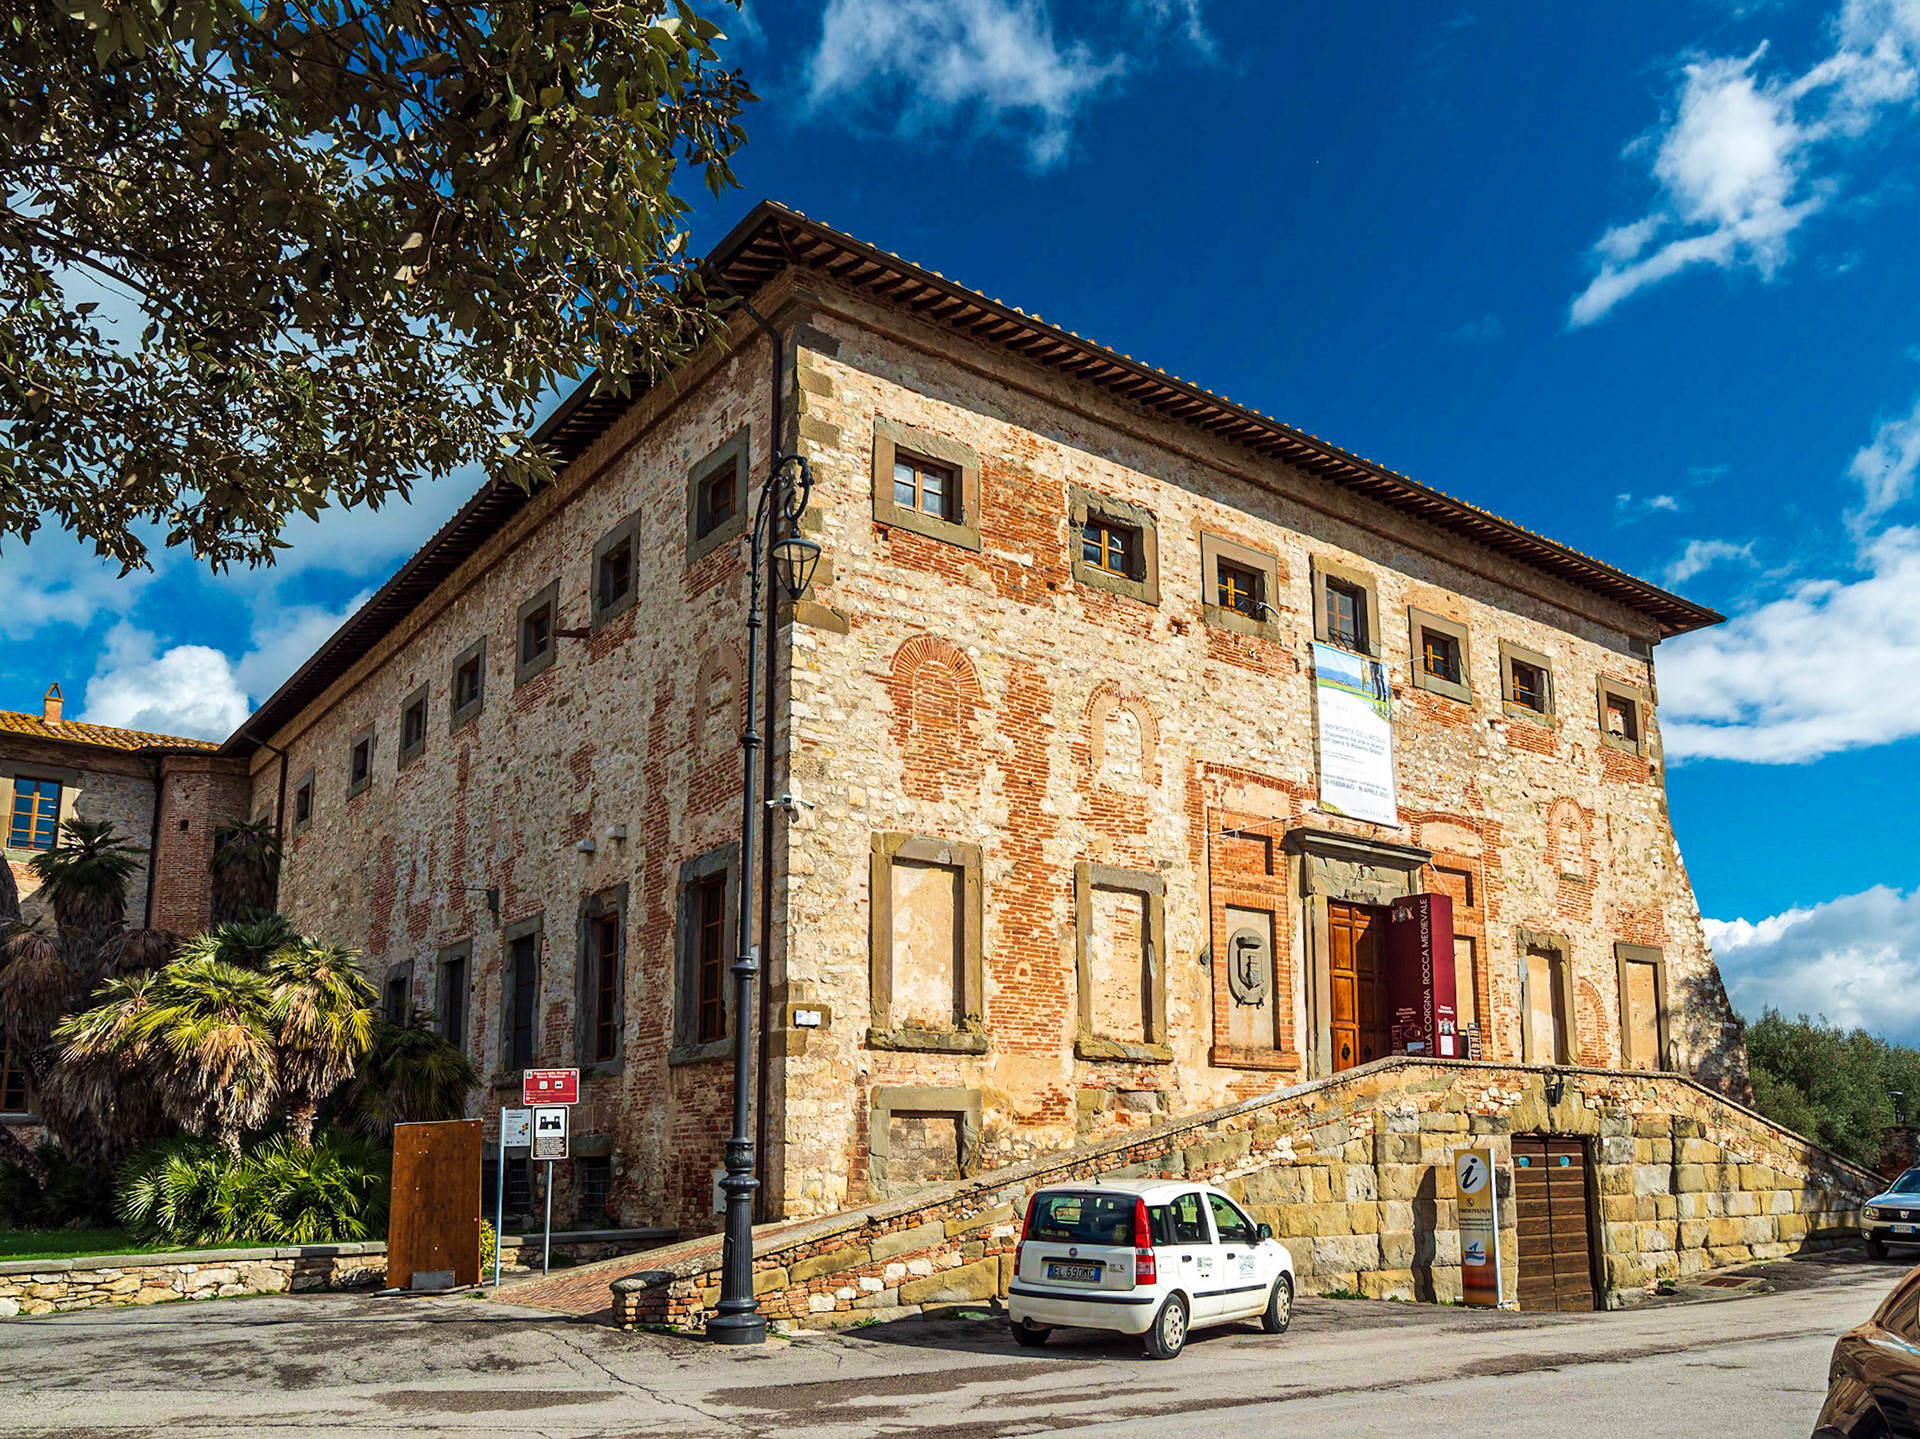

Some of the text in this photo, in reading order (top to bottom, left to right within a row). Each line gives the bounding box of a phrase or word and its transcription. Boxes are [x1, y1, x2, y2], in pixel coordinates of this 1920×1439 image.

[1330, 779, 1355, 791] FEBBRAIO
[1364, 787, 1379, 797] APRILE
[1419, 898, 1428, 948] MEDIEVALE
[1421, 949, 1431, 985] ROCCA
[1423, 988, 1432, 1032] CORGNA
[1053, 1265, 1094, 1279] EL 690MC
